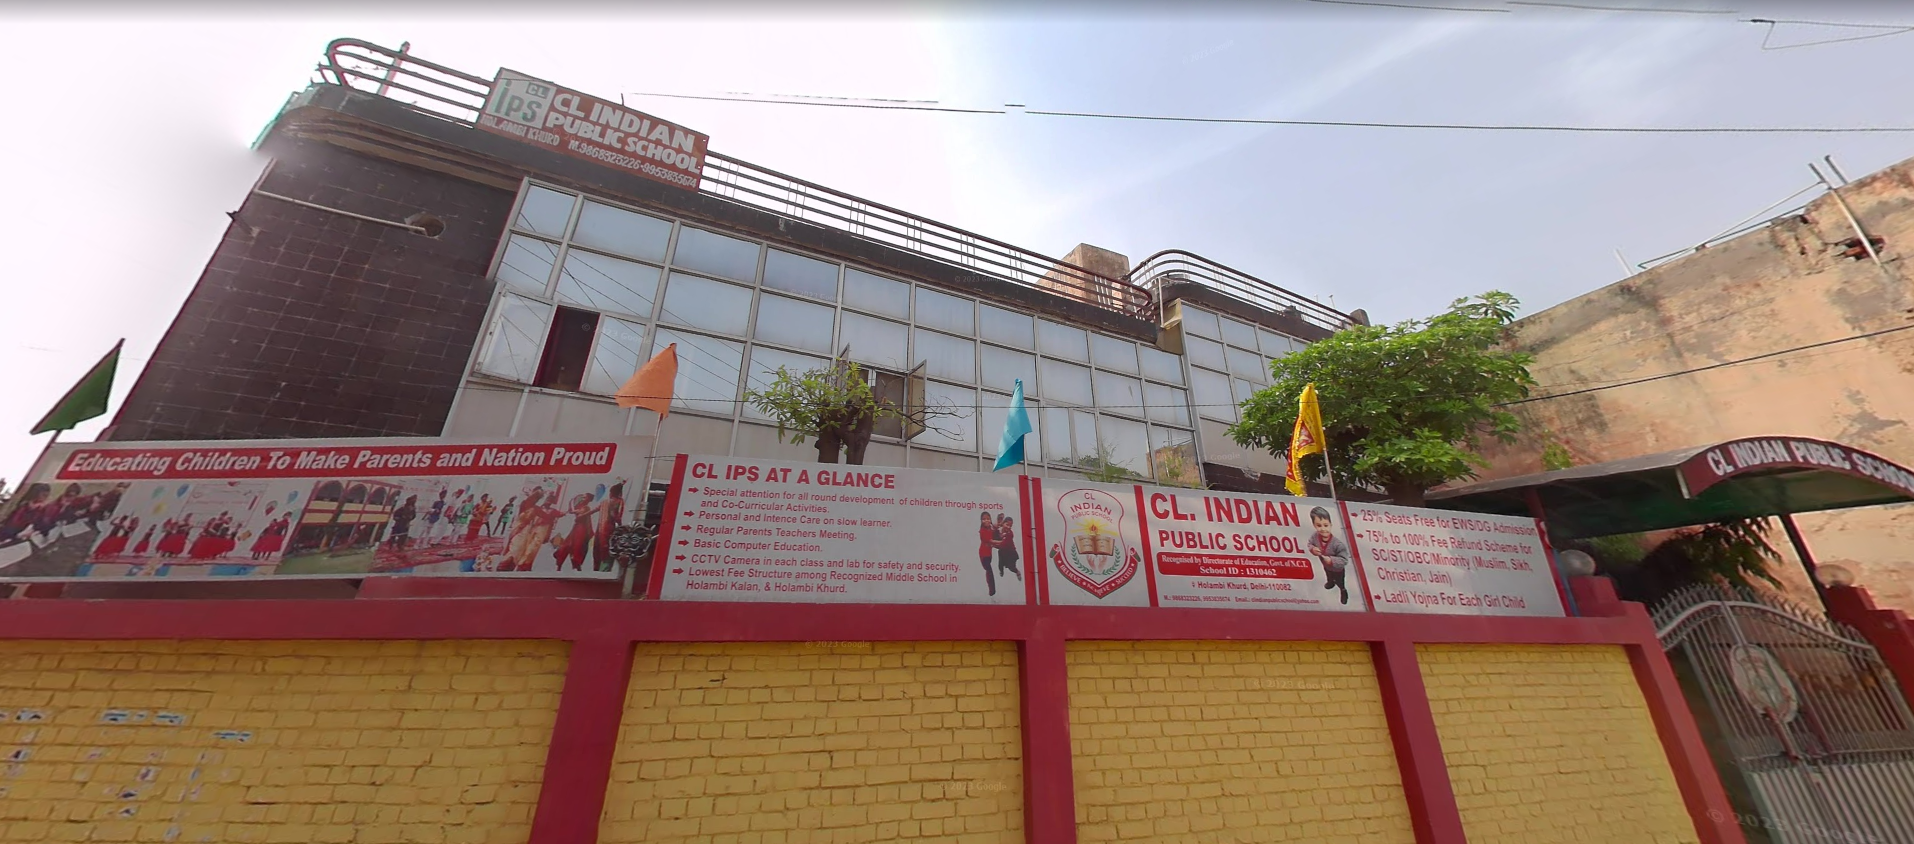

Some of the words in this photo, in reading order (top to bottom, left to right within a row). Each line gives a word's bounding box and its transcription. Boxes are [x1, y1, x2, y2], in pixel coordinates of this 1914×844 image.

[527, 84, 546, 98] CL
[553, 93, 585, 118] CL
[589, 102, 695, 153] INDIAN
[545, 111, 624, 149] PUBLIC
[624, 137, 700, 174] SCHOOL
[67, 453, 173, 475] Educating
[175, 452, 261, 471] Children
[267, 451, 291, 470] To
[294, 450, 350, 470] Make
[353, 450, 432, 468] Parents
[436, 448, 477, 467] and
[479, 447, 546, 466] Nation
[549, 446, 610, 466] Proud
[1706, 449, 1735, 476] CL
[1728, 439, 1792, 468] INDIAN
[1789, 440, 1851, 470] PUBLIC
[692, 462, 718, 479] CL
[725, 464, 760, 482] IPS
[765, 467, 792, 483] AT
[797, 469, 810, 485] A
[816, 470, 895, 489] GLANCE
[703, 486, 738, 497] Special
[740, 488, 780, 499] attention
[783, 490, 796, 500] for
[797, 491, 809, 500] all
[811, 492, 837, 502] round
[839, 493, 894, 505] development
[899, 497, 908, 506] of
[909, 498, 942, 507] children
[945, 500, 977, 511] through
[978, 502, 1004, 511] sports
[1084, 492, 1096, 500] CL
[700, 499, 718, 508] and
[721, 499, 784, 511] Co-Curricular
[786, 503, 829, 513] Activities.
[1070, 502, 1112, 515] INDIAN
[1150, 492, 1196, 521] CL.
[1203, 496, 1301, 527] INDIAN
[699, 510, 741, 521] Personal
[743, 513, 761, 522] and
[763, 514, 797, 524] Intence
[800, 515, 821, 525] Care
[823, 518, 835, 526] on
[837, 517, 858, 526] slow
[860, 518, 892, 527] learner.
[1070, 510, 1090, 520] PUBLIC
[1091, 511, 1113, 523] SCHOOL
[1361, 509, 1383, 523] 25%
[1384, 511, 1412, 526] Seats
[1414, 514, 1435, 528] Free
[1436, 516, 1450, 529] for
[1451, 517, 1492, 532] EWS/DG
[1493, 521, 1538, 537] Admission
[696, 524, 735, 536] Regular
[737, 525, 772, 536] Parents
[775, 527, 817, 538] Teachers
[819, 529, 857, 541] Meeting.
[1158, 529, 1227, 550] PUBLIC
[1232, 533, 1305, 554] SCHOOL
[693, 538, 721, 549] Basic
[723, 539, 771, 551] Computer
[773, 541, 823, 552] Education.
[1366, 530, 1389, 543] 75%
[1389, 532, 1401, 544] to
[1402, 533, 1430, 547] 100%
[1430, 535, 1448, 548] Fee
[1449, 536, 1483, 551] Refund
[1484, 539, 1519, 553] Scheme
[1519, 541, 1532, 555] for
[691, 554, 721, 564] CCTV
[723, 555, 761, 566] Camera
[763, 556, 772, 566] in
[774, 556, 797, 567] each
[800, 557, 824, 568] class
[827, 558, 844, 568] and
[846, 559, 860, 569] lab
[862, 560, 875, 569] for
[877, 560, 904, 571] safety
[906, 561, 923, 570] and
[925, 562, 961, 573] security.
[1161, 555, 1194, 564] Recognised
[1194, 556, 1201, 565] by
[1202, 556, 1234, 565] Directorate
[1241, 558, 1269, 567] Education,
[1269, 559, 1284, 568] Govt.
[1285, 559, 1290, 567] of
[1371, 548, 1470, 570] SC/ST/OBC/Minority
[1472, 555, 1510, 571] (Muslim,
[1511, 558, 1533, 572] Sikh,
[688, 567, 725, 577] Lowest
[727, 568, 745, 578] Fee
[747, 568, 793, 579] Structure
[795, 571, 827, 582] among
[830, 571, 883, 583] Recognized
[885, 572, 915, 582] Middle
[917, 573, 947, 583] School
[949, 574, 958, 583] in
[1060, 564, 1081, 583] BELIEVE
[1199, 566, 1227, 575] School
[1228, 567, 1239, 575] ID
[1246, 567, 1277, 576] 1310462
[1377, 566, 1427, 584] Christian,
[1428, 570, 1453, 587] Jain)
[686, 580, 728, 591] Holambi
[730, 581, 761, 593] Kalan,
[763, 582, 771, 591] &
[774, 582, 814, 592] Holambi
[816, 583, 848, 593] Khurd.
[1197, 581, 1226, 590] Holambi
[1227, 582, 1249, 591] Khurd,
[1382, 590, 1409, 604] Ladli
[1410, 590, 1439, 608] Yojna
[1440, 592, 1457, 606] For
[1458, 593, 1481, 607] Each
[1485, 594, 1501, 607] Girl
[1501, 595, 1526, 609] Child
